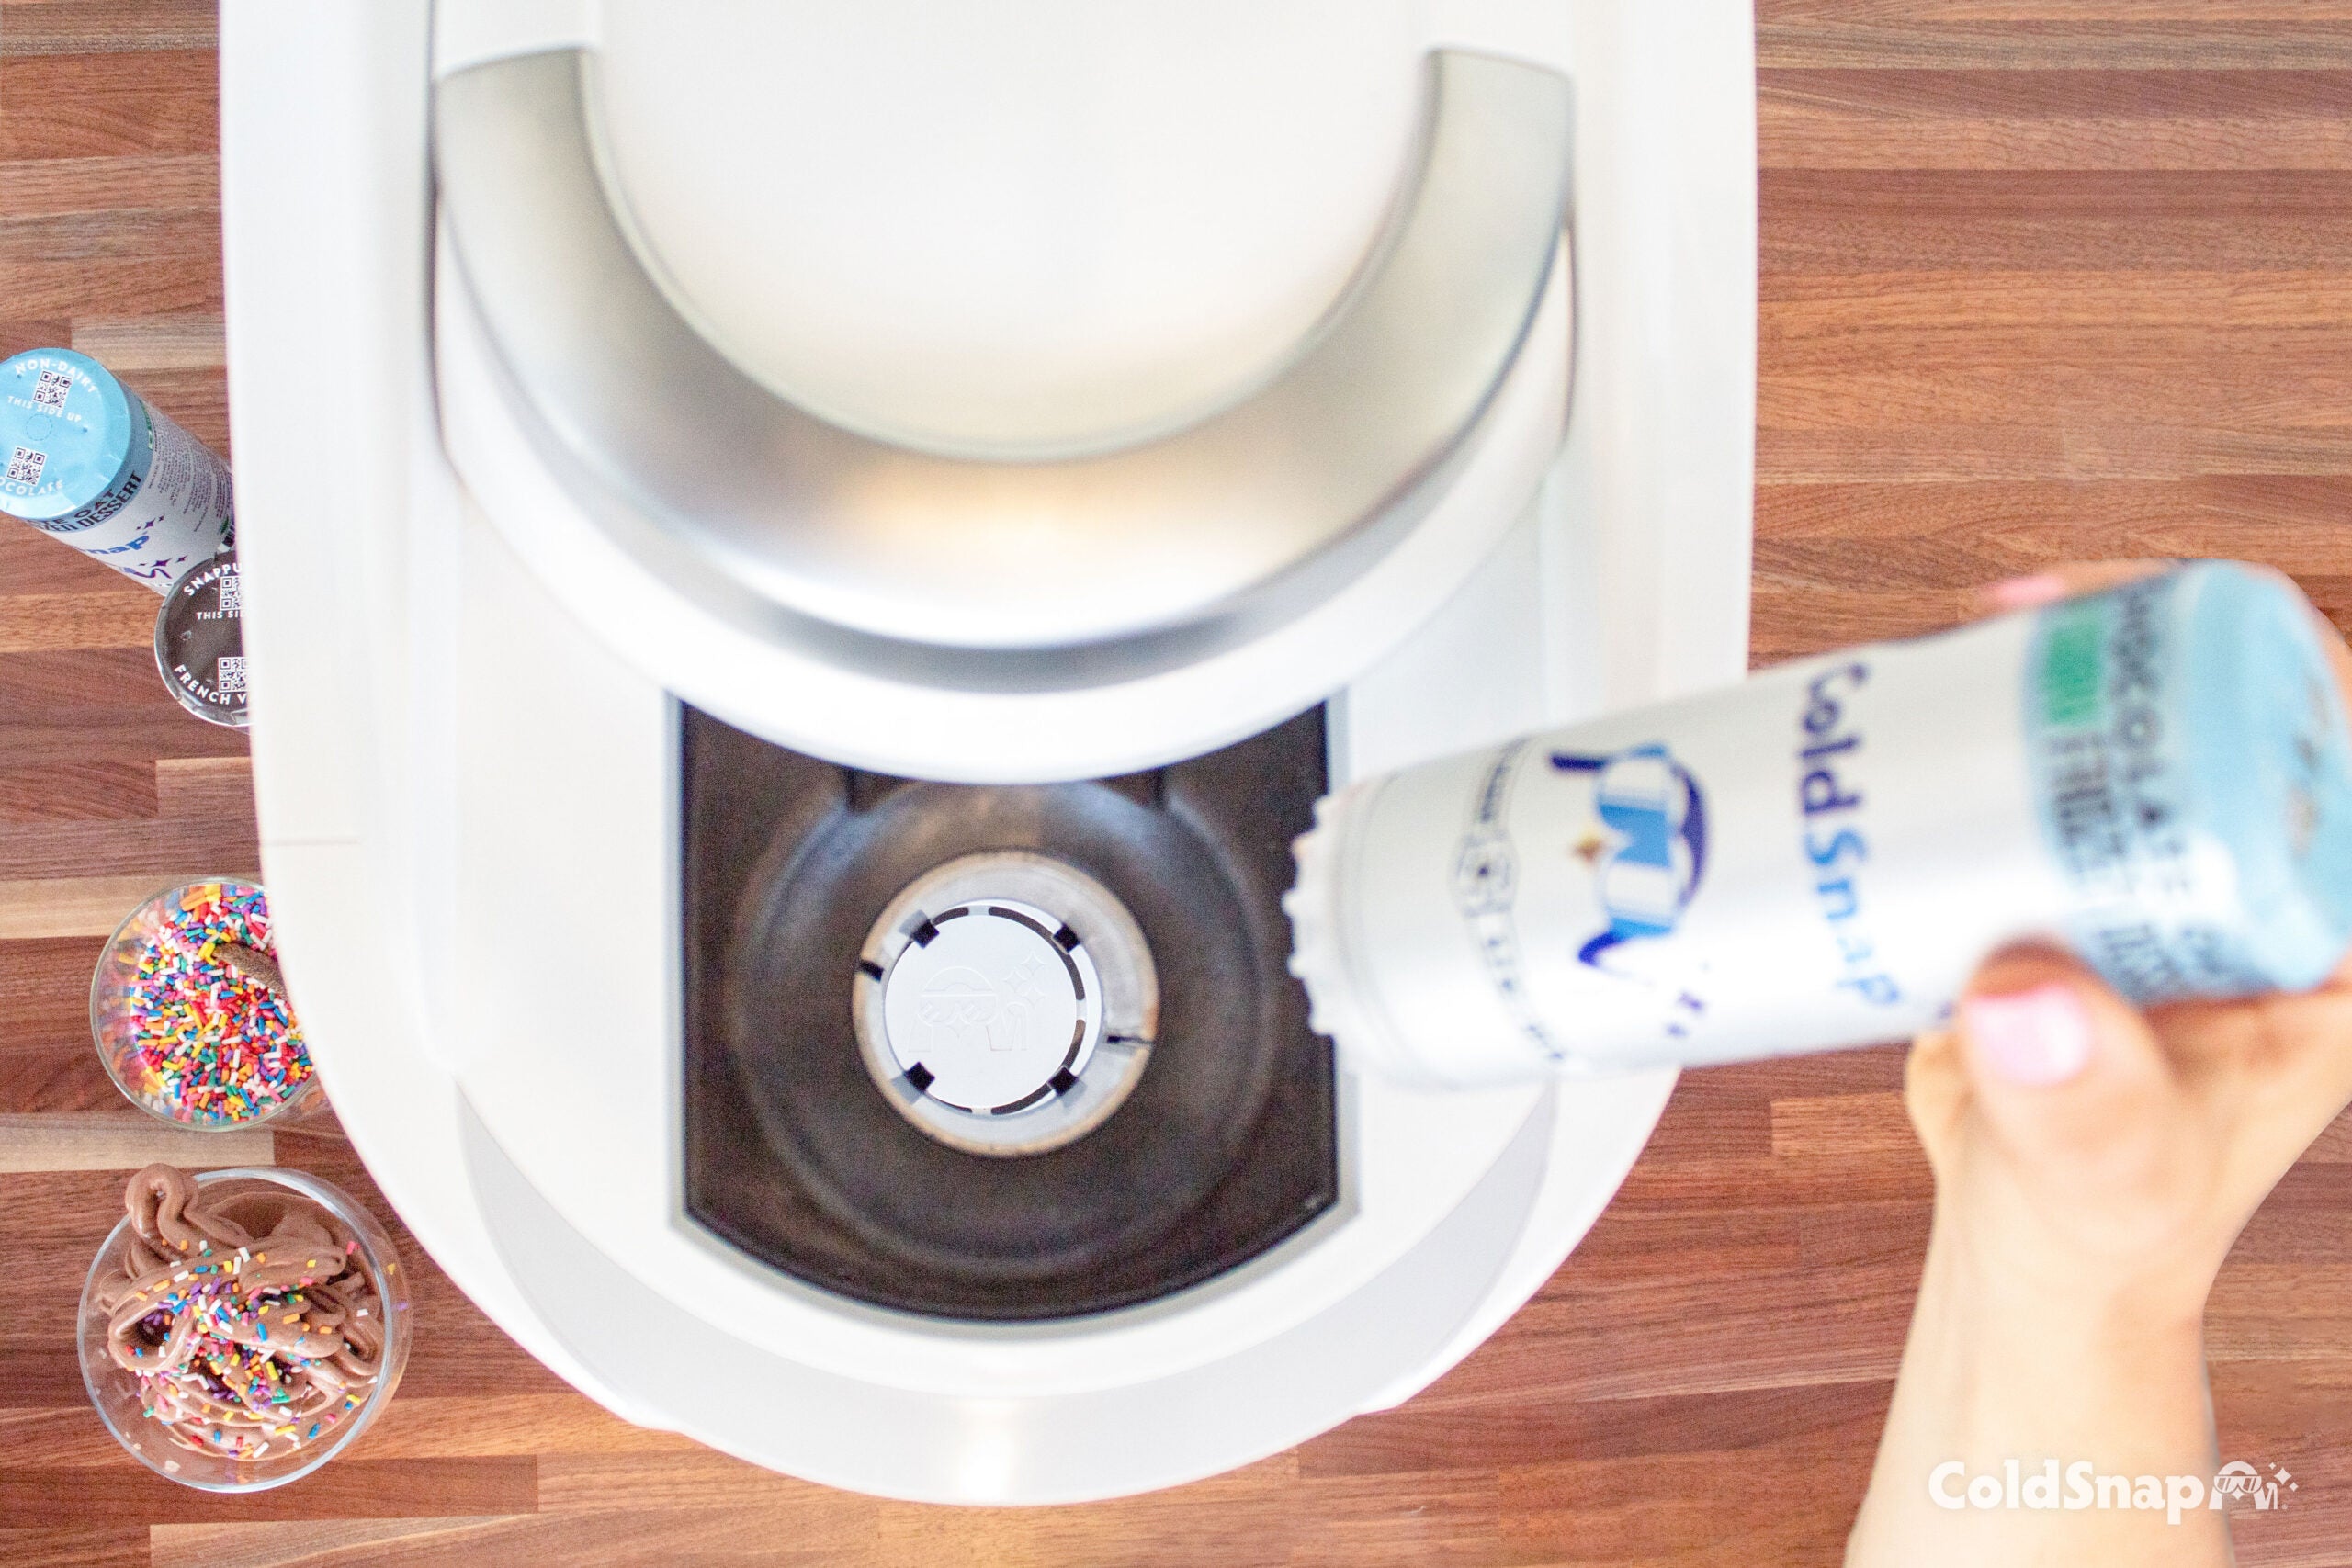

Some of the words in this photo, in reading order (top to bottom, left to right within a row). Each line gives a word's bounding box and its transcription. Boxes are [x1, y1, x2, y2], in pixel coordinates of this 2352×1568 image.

[15, 357, 96, 393] NON-DAIRY
[7, 396, 33, 410] THIS
[36, 404, 63, 418] SIDE
[66, 412, 83, 423] UP
[74, 488, 115, 519] OAT
[76, 469, 142, 528] DESSERT
[196, 610, 224, 620] THIS
[174, 664, 232, 705] FRENCH
[1799, 661, 1903, 1007] ColdSnap
